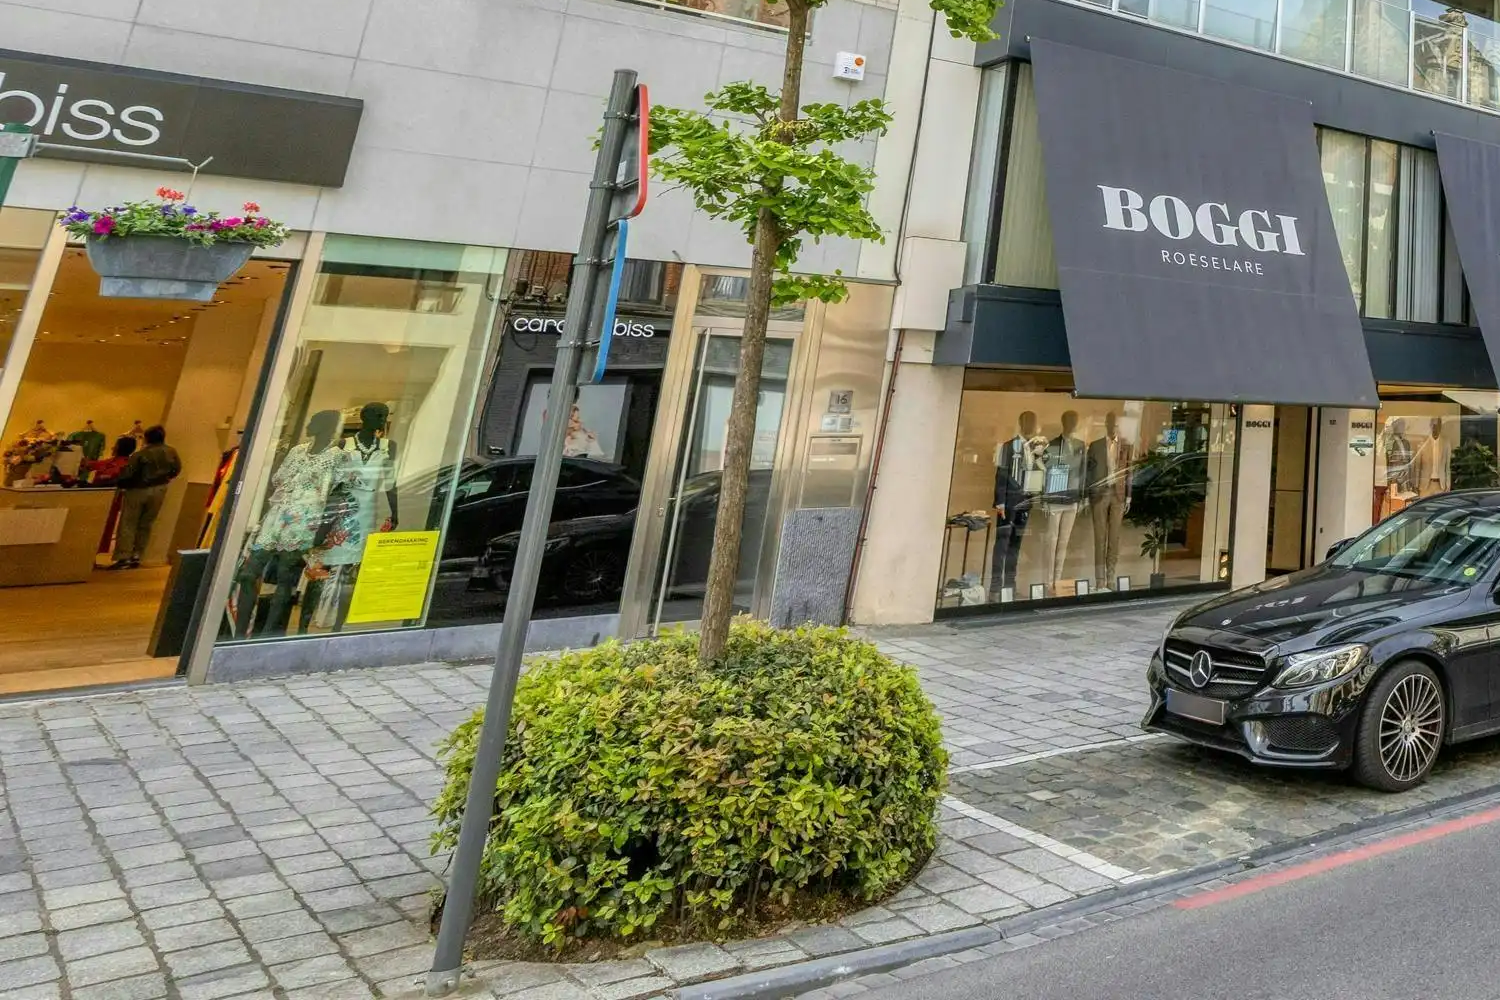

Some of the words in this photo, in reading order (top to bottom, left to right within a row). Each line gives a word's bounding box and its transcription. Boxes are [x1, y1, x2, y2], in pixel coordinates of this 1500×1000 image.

[1097, 184, 1306, 256] BOGGI
[1161, 249, 1264, 276] ROESELARE
[612, 318, 655, 338] biss
[837, 394, 848, 405] 16
